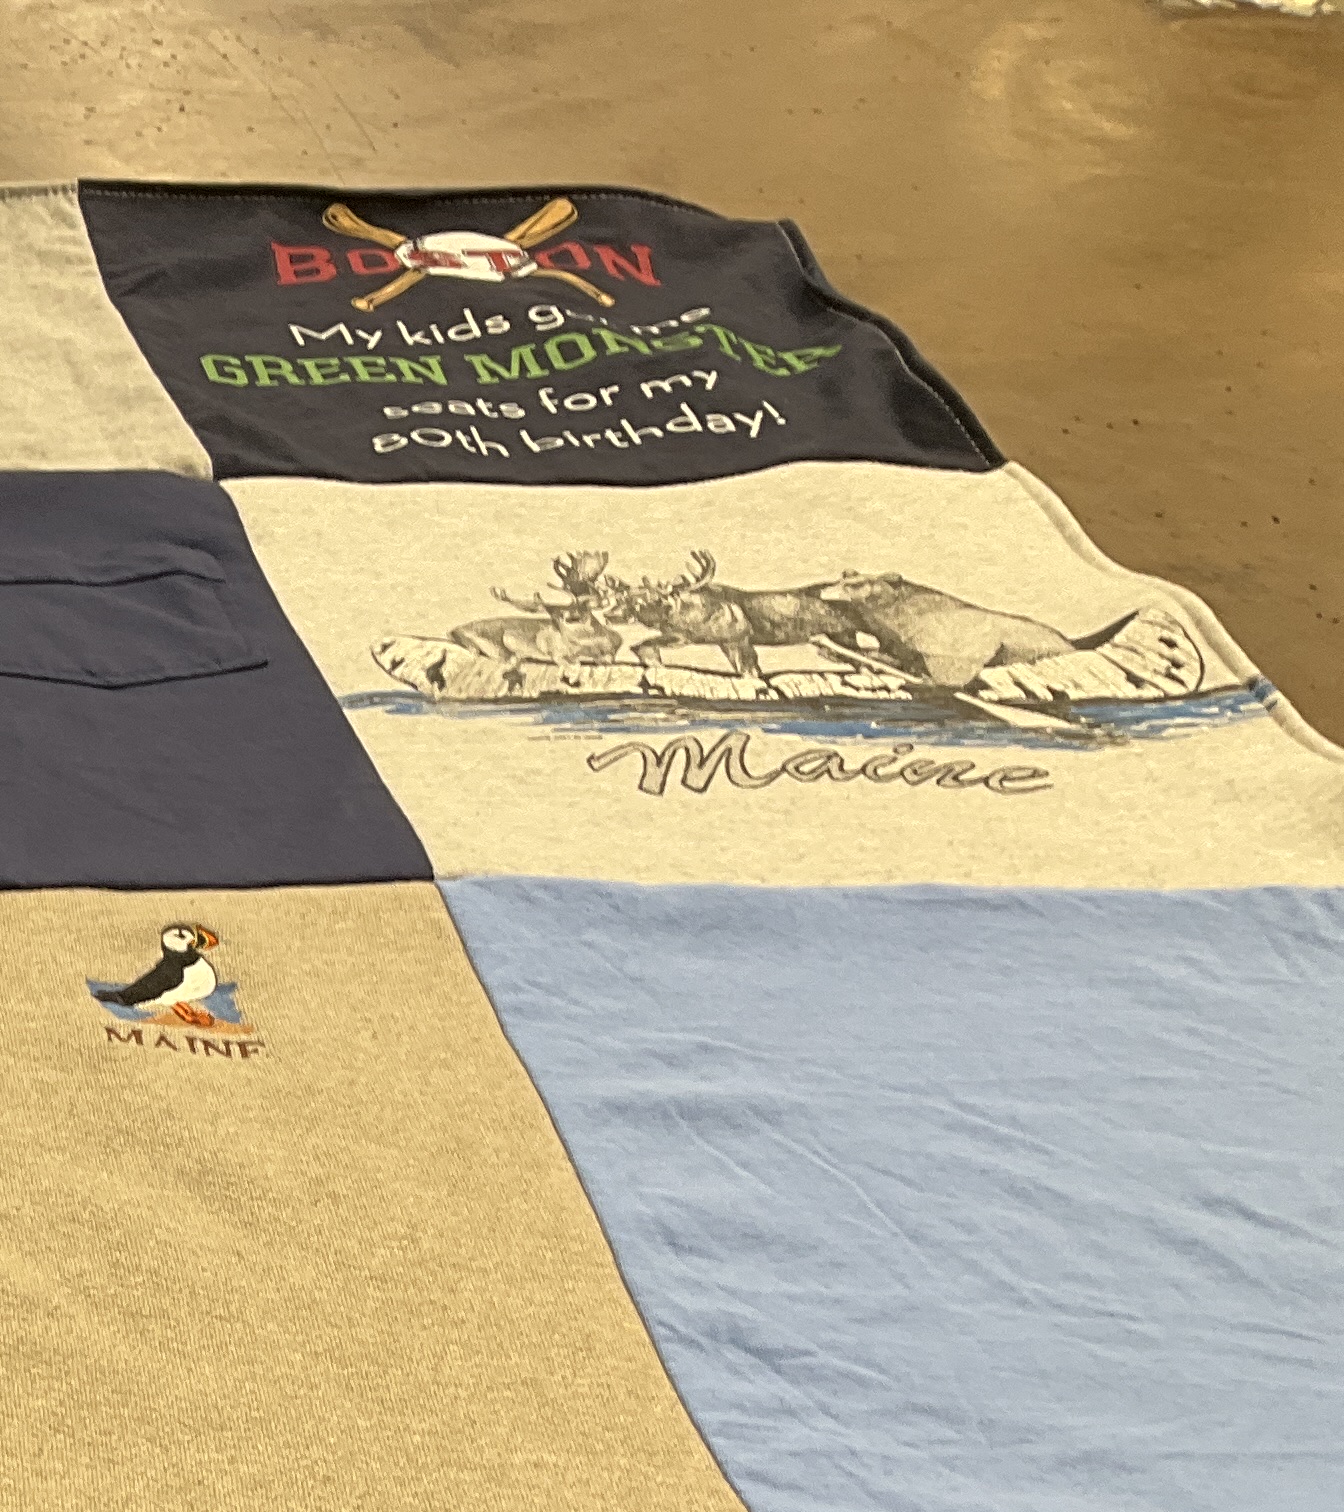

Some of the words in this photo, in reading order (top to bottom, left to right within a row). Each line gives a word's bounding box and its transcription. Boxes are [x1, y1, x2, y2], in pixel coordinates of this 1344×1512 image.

[271, 240, 662, 287] BOSTON
[288, 312, 382, 350] My
[397, 308, 511, 346] kids
[199, 354, 449, 387] GREEN
[383, 398, 526, 420] seats
[539, 385, 620, 415] for
[641, 370, 718, 398] my
[519, 401, 787, 453] birthday!
[587, 730, 1053, 796] Maine
